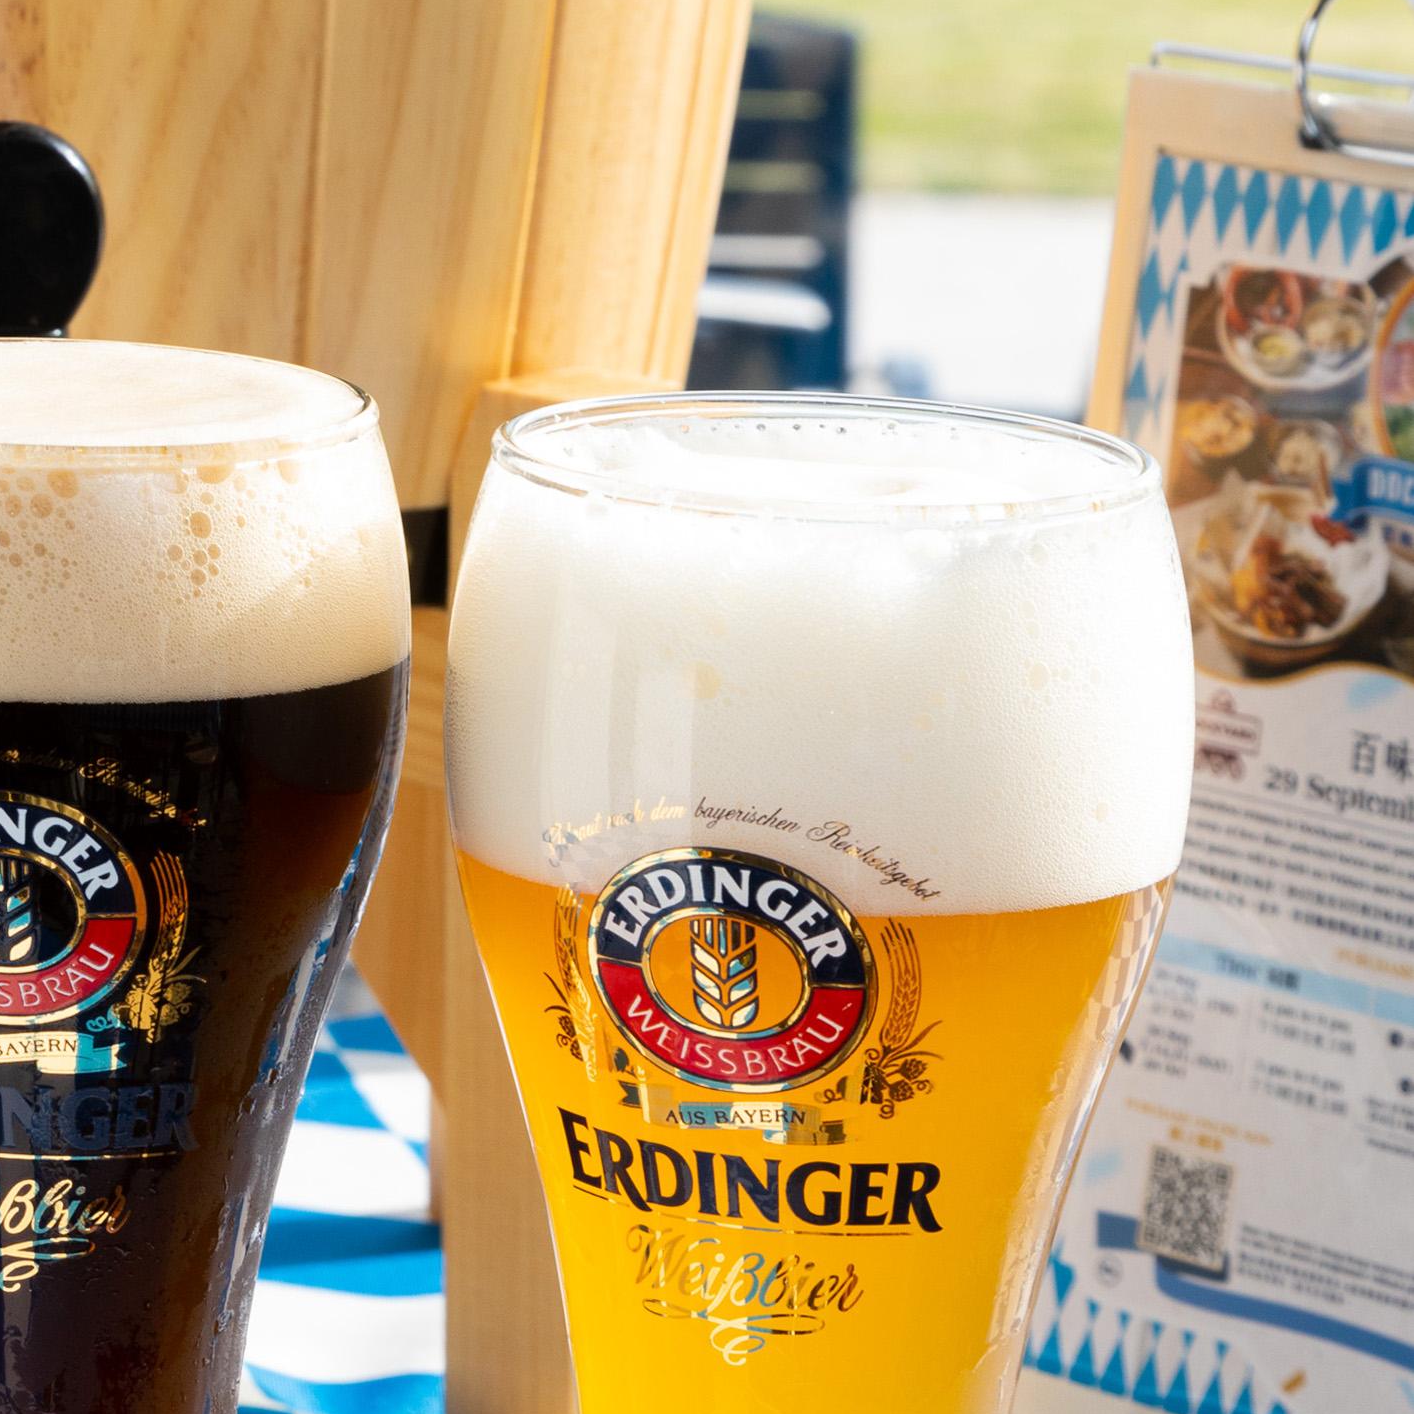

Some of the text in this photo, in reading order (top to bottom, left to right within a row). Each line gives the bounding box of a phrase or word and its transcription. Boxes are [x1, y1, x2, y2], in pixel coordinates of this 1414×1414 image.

[694, 796, 801, 829] bayerischen
[604, 864, 848, 969] ERDINGER
[626, 994, 845, 1078] WEISSBRÄU
[666, 1109, 806, 1126] AUS BAYERN
[557, 1106, 943, 1233] ERDINGER
[627, 1223, 865, 1313] Weißbier
